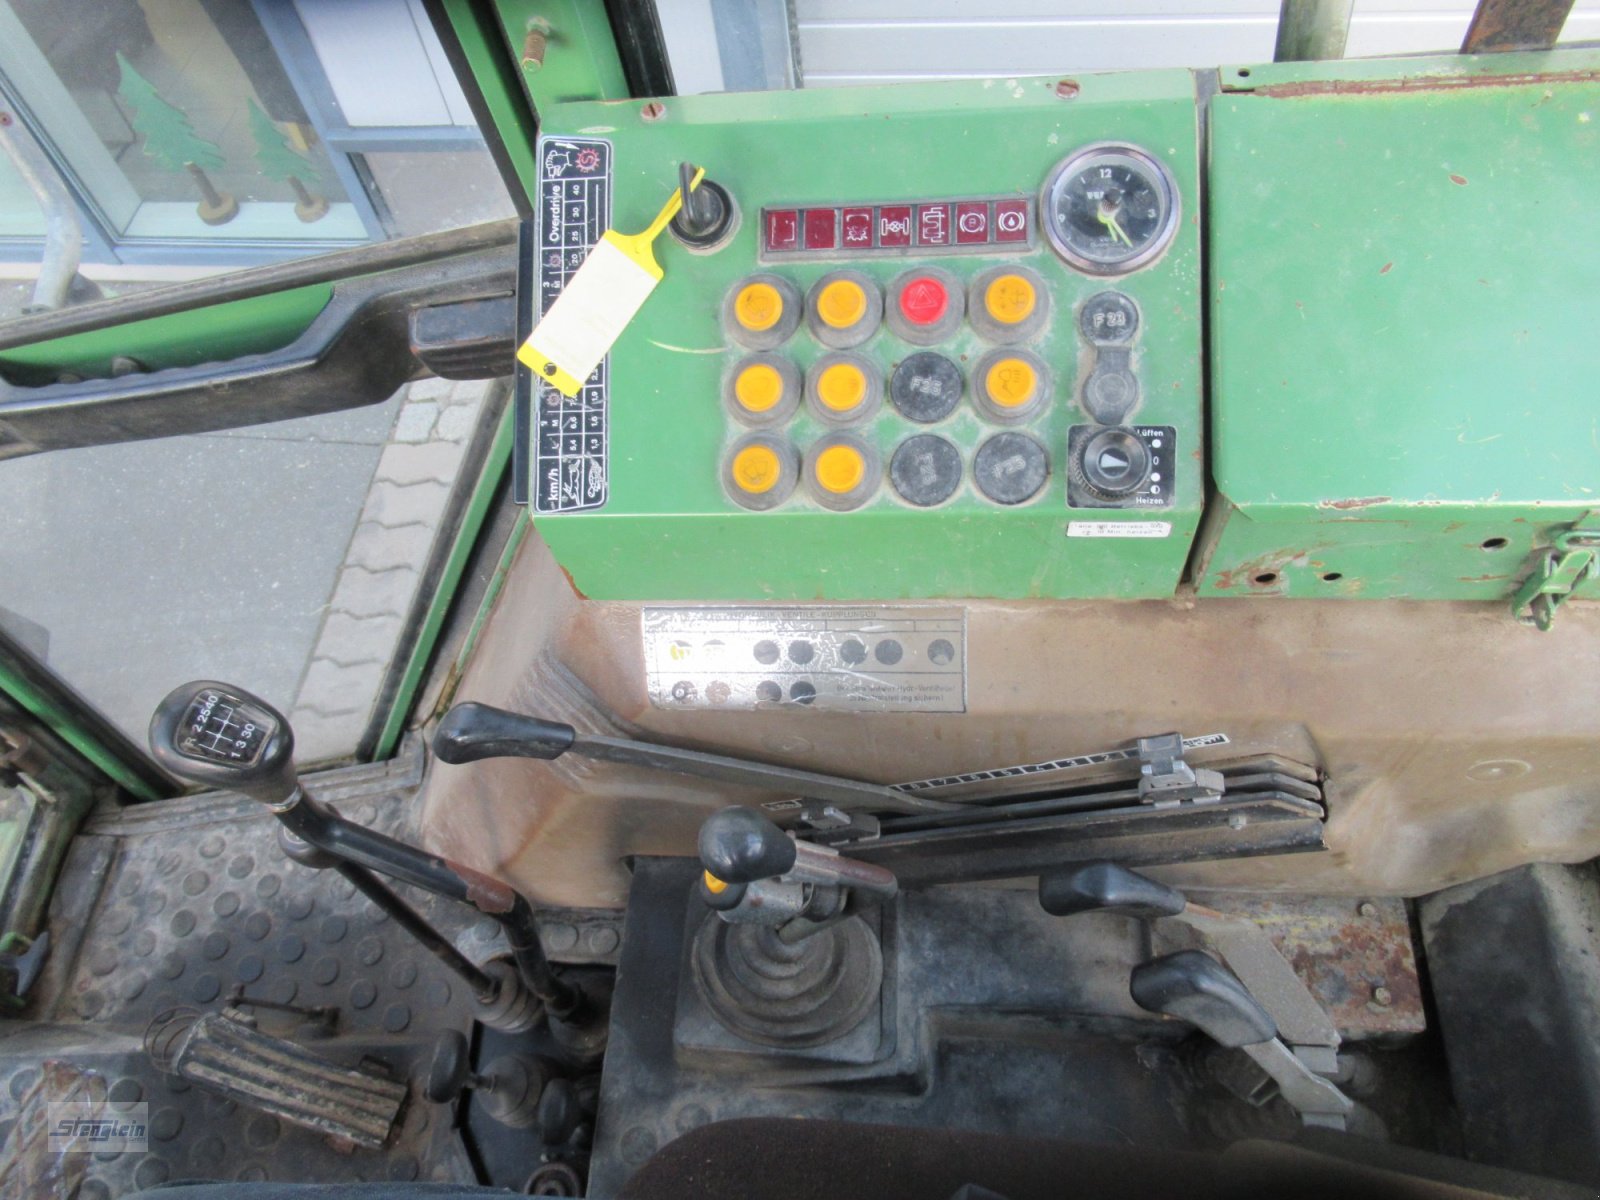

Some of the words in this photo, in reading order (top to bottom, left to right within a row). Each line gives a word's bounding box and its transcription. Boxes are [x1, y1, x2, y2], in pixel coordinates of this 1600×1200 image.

[1099, 168, 1112, 178] 12
[573, 184, 580, 196] 40
[549, 184, 561, 242] Overdrive
[1058, 213, 1066, 223] 9
[1147, 209, 1156, 218] 3
[1152, 455, 1160, 466] 0
[547, 468, 559, 501] km/h
[1136, 496, 1164, 505] Heizen
[184, 736, 198, 747] R
[192, 724, 202, 732] 2
[198, 707, 210, 723] 25
[204, 695, 218, 710] 40
[235, 740, 247, 749] 3
[241, 723, 255, 738] 30
